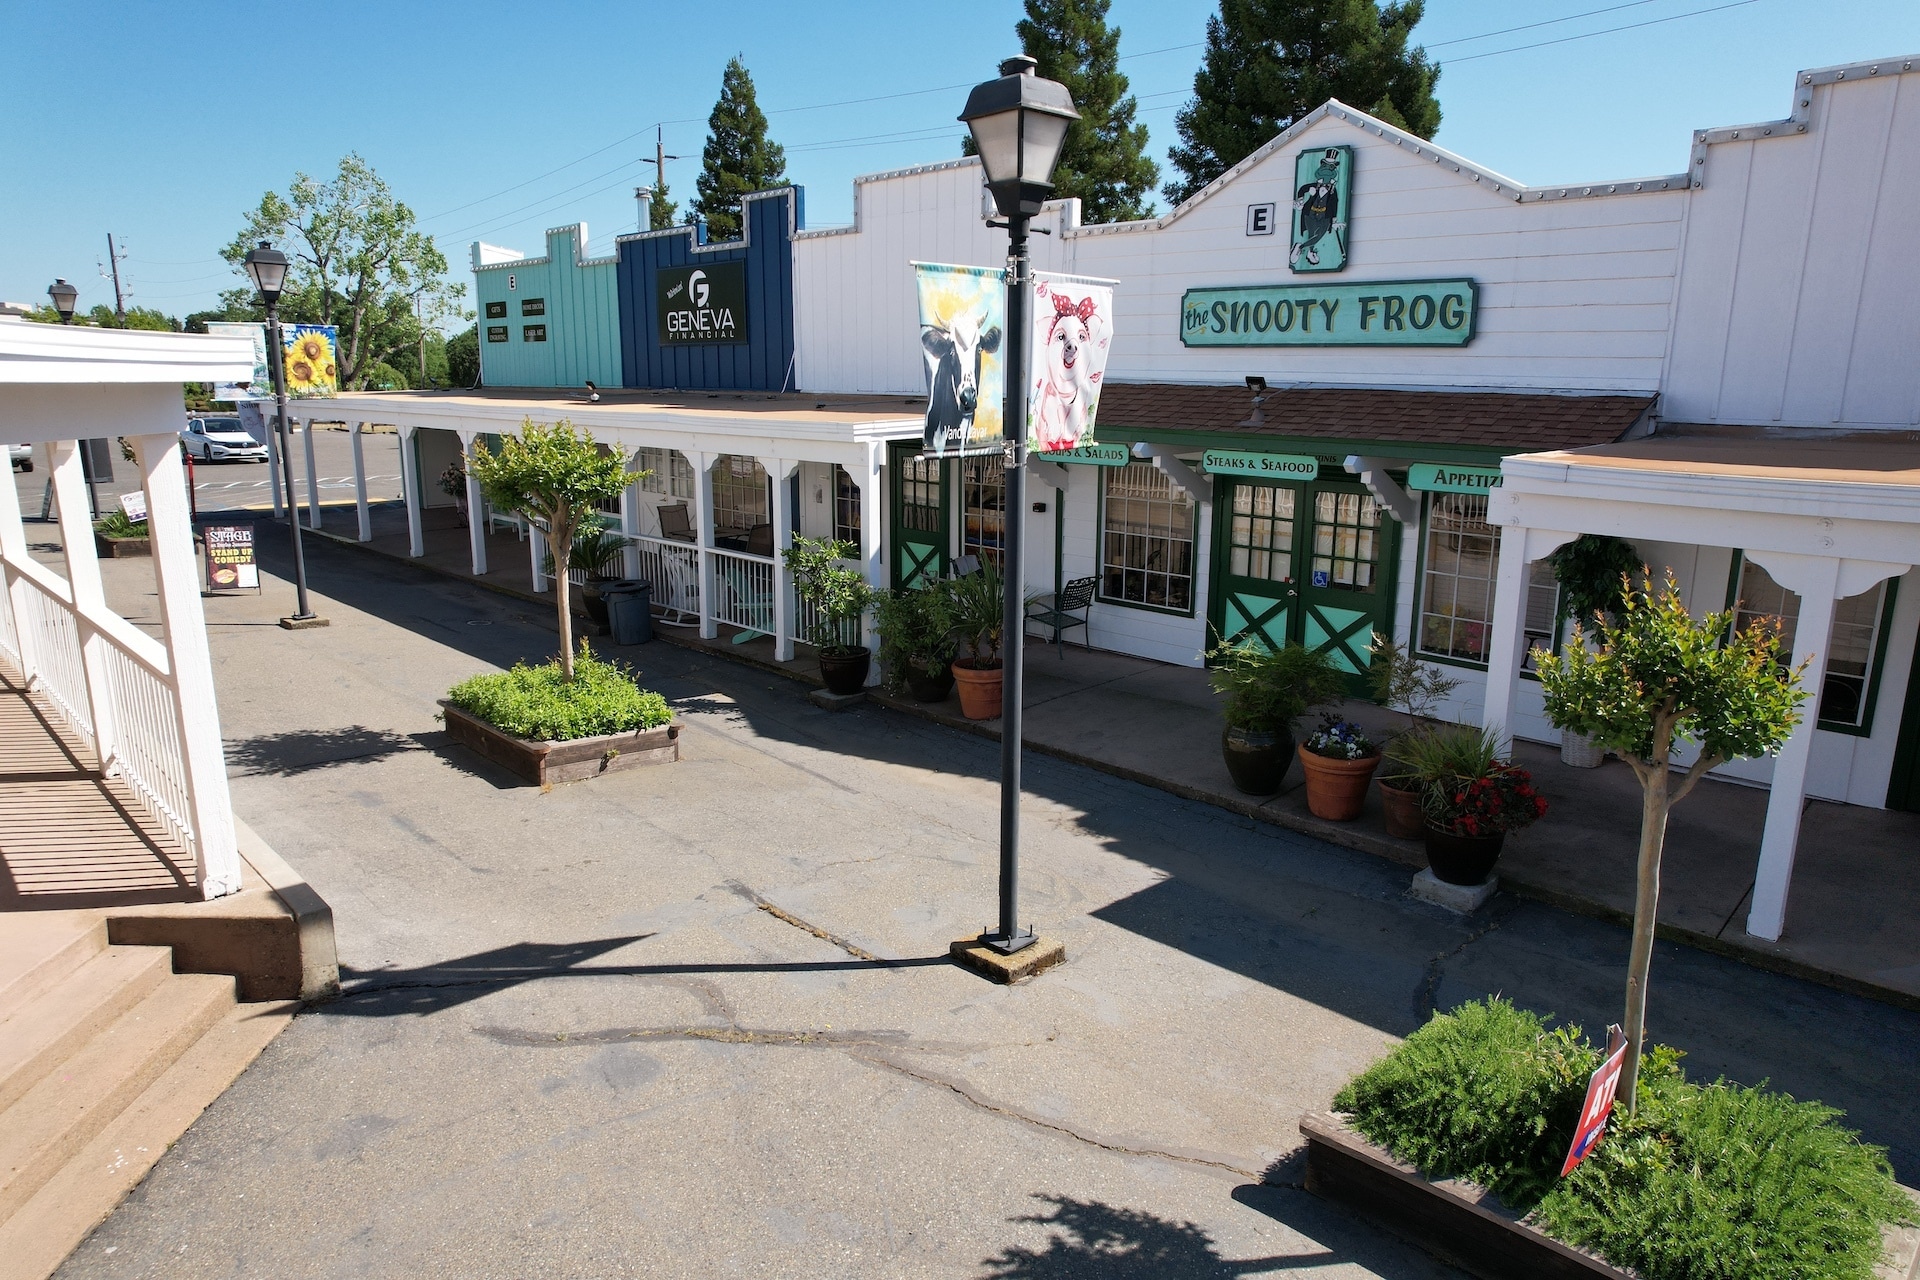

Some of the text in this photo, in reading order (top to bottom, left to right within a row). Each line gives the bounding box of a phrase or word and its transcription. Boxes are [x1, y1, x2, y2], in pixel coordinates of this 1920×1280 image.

[1253, 208, 1268, 231] E
[667, 308, 735, 331] GENEVA
[1185, 293, 1467, 334] the SNOOTY FROG
[669, 330, 735, 340] FINANCIAL
[1042, 445, 1124, 460] UPS & SALADS
[1206, 454, 1314, 473] STEAKS & SEAFOOD
[210, 531, 252, 542] STAGE
[210, 548, 253, 557] STAND UP
[214, 555, 252, 564] COMEDY
